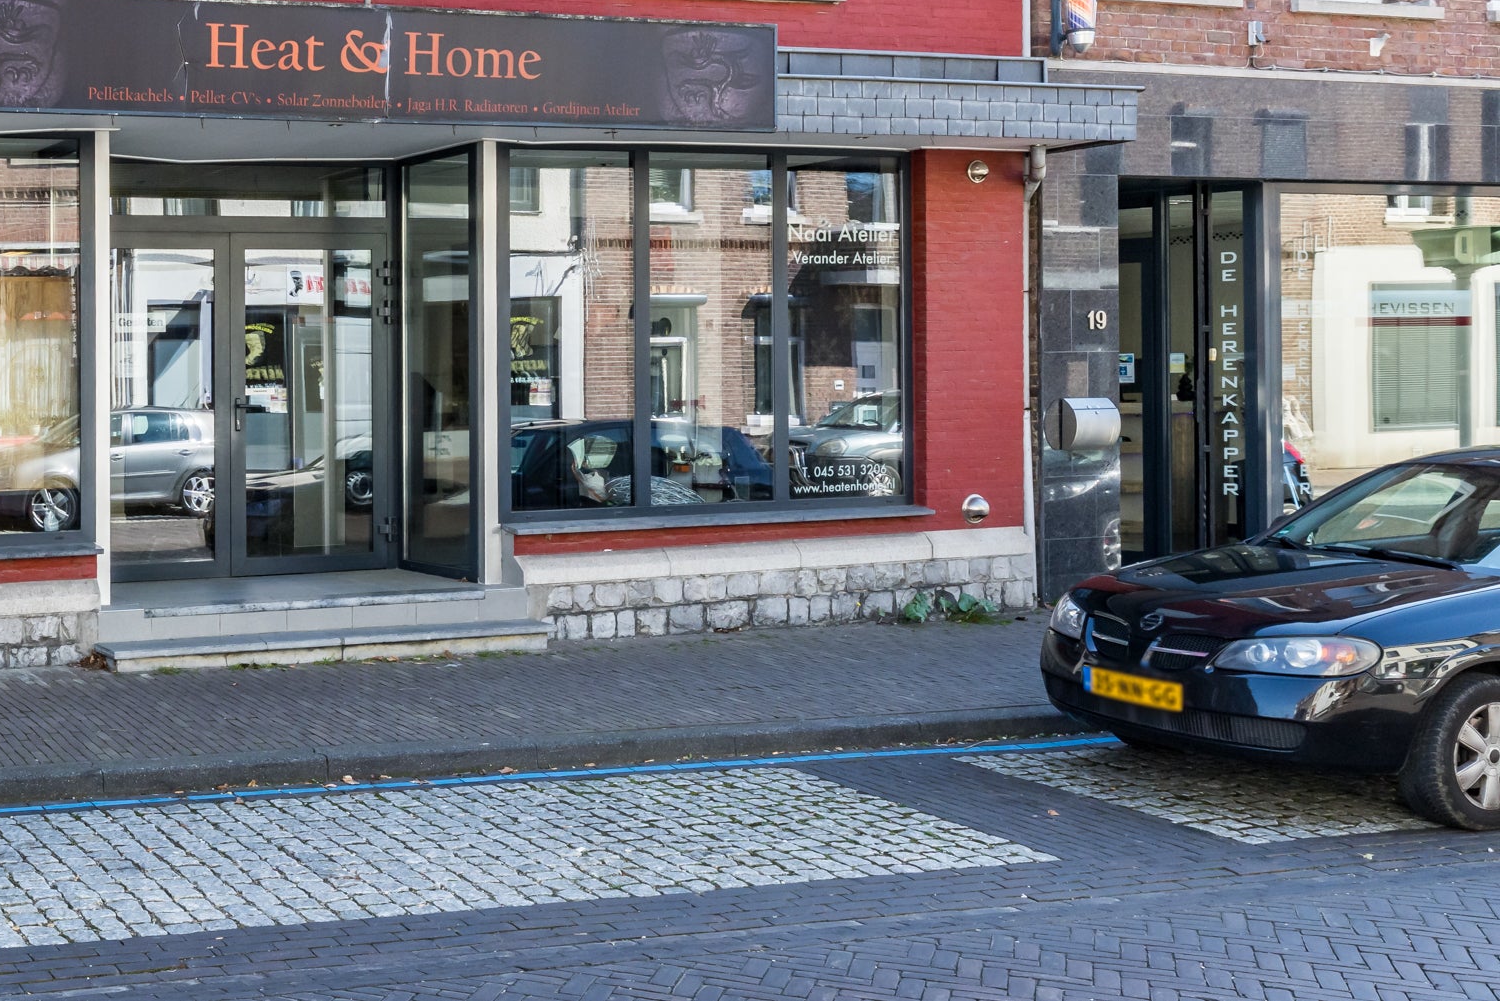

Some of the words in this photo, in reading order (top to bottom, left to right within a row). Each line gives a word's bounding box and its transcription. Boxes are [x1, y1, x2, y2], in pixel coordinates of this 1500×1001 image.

[205, 22, 326, 71] Heat
[340, 29, 391, 73] &
[404, 31, 542, 80] Home
[88, 86, 174, 103] Pelletkachels
[277, 93, 309, 107] Solar
[312, 94, 392, 110] Zonneboilers
[406, 98, 431, 114] Jaga
[435, 99, 460, 112] H.R.
[465, 99, 528, 114] Radiatoren
[542, 101, 600, 118] Gordijnen
[604, 103, 640, 116] Atelier
[787, 223, 832, 242] Naai
[838, 223, 894, 242] Atelier
[792, 249, 849, 264] Verander
[852, 250, 892, 265] Atelier
[1220, 251, 1237, 282] DE
[118, 317, 164, 327] Geten
[1087, 310, 1107, 330] 19
[1220, 304, 1239, 496] HERENKAPPER
[802, 466, 810, 478] T.
[814, 466, 834, 478] 045
[837, 464, 856, 476] 531
[860, 463, 887, 475] 3206
